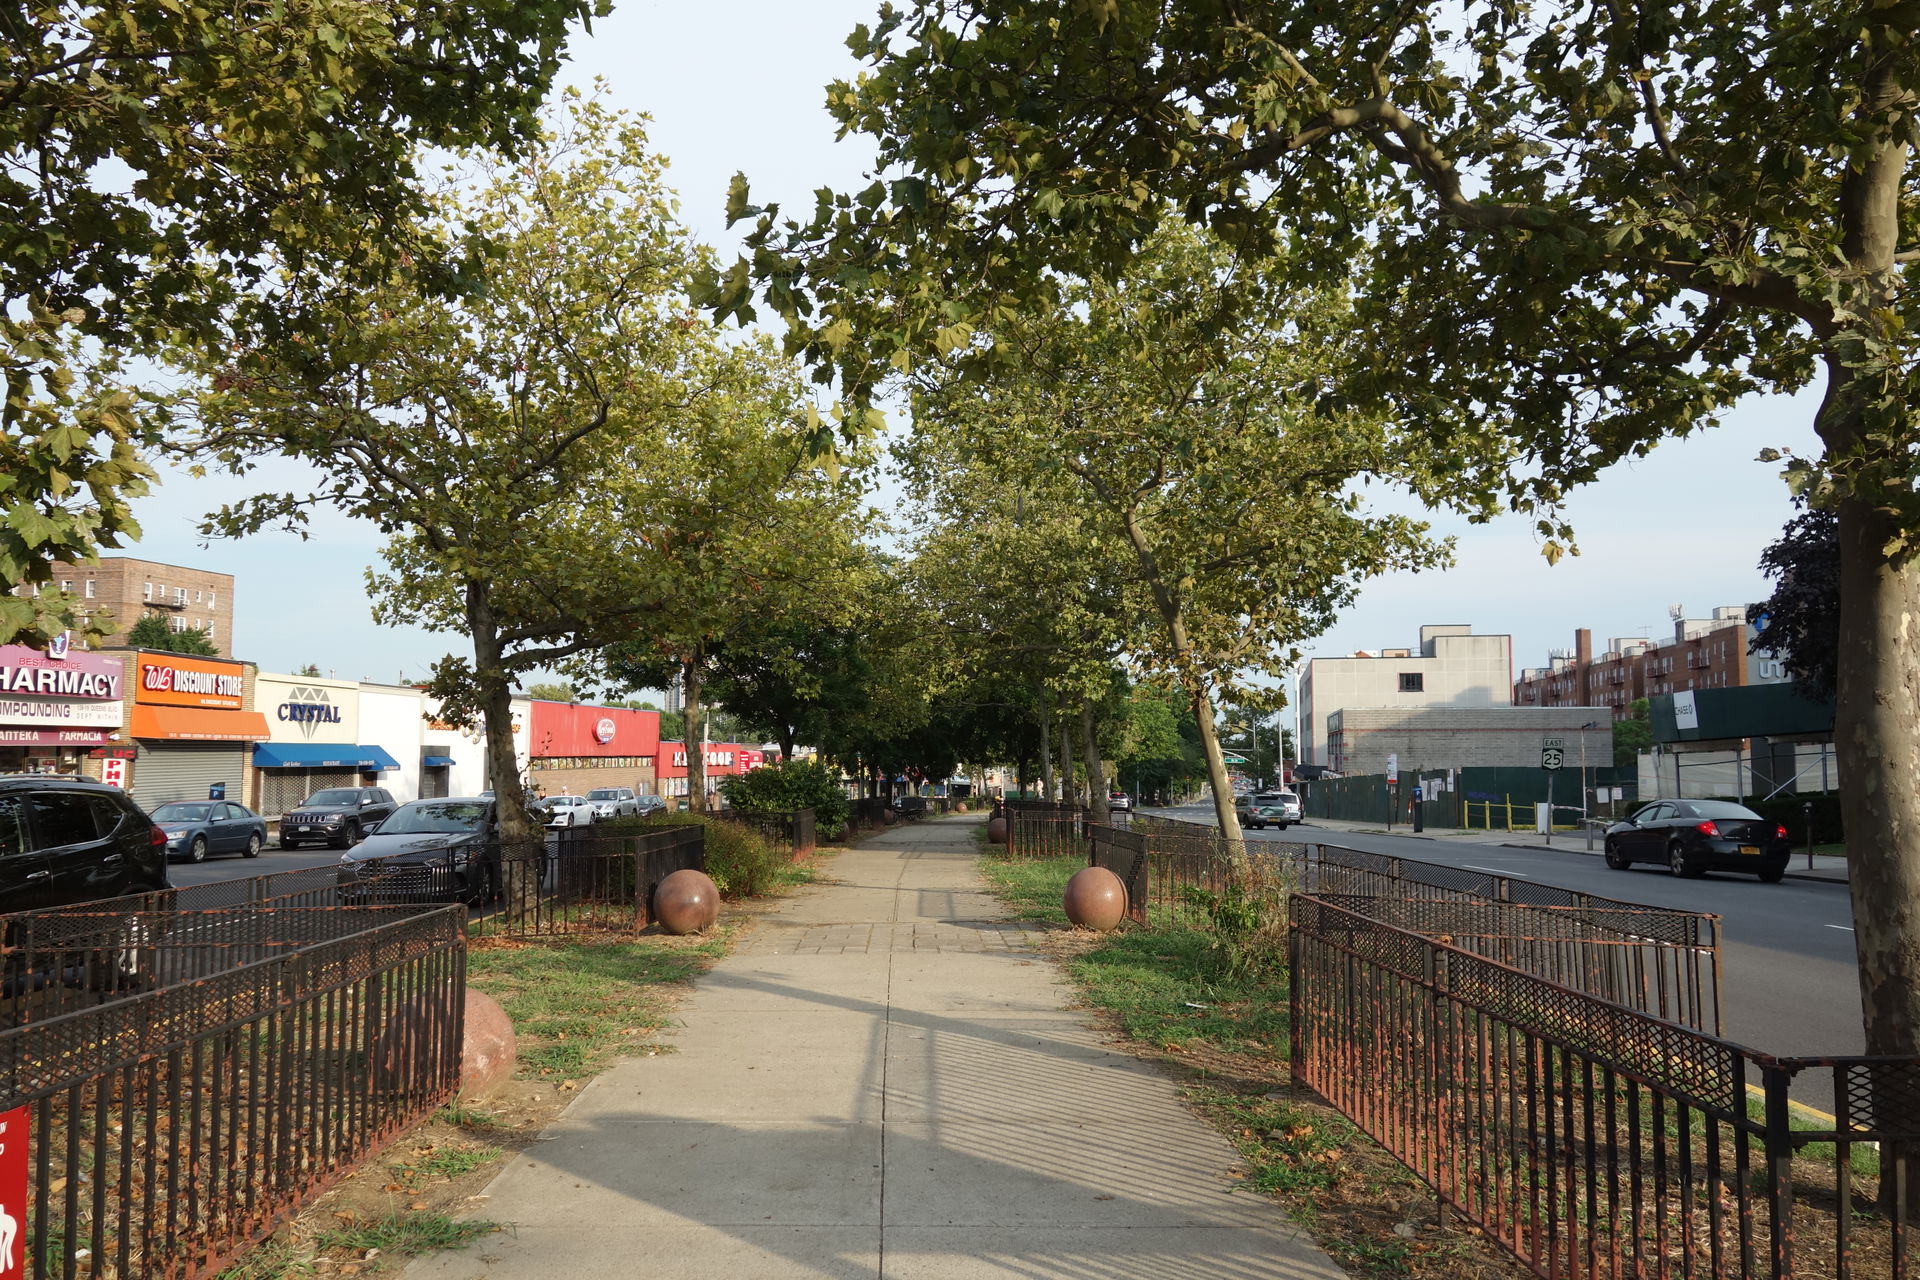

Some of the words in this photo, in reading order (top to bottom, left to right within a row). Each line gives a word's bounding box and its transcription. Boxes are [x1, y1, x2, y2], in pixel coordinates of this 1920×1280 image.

[18, 658, 46, 666] BEST
[49, 660, 82, 670] CHOICE
[174, 669, 217, 695] DISCOUNT
[217, 674, 243, 697] STORE
[0, 701, 71, 718] MPOUNDING
[277, 703, 342, 723] CRYSTAL
[59, 731, 102, 742] FARMACIA
[1544, 753, 1561, 766] 25
